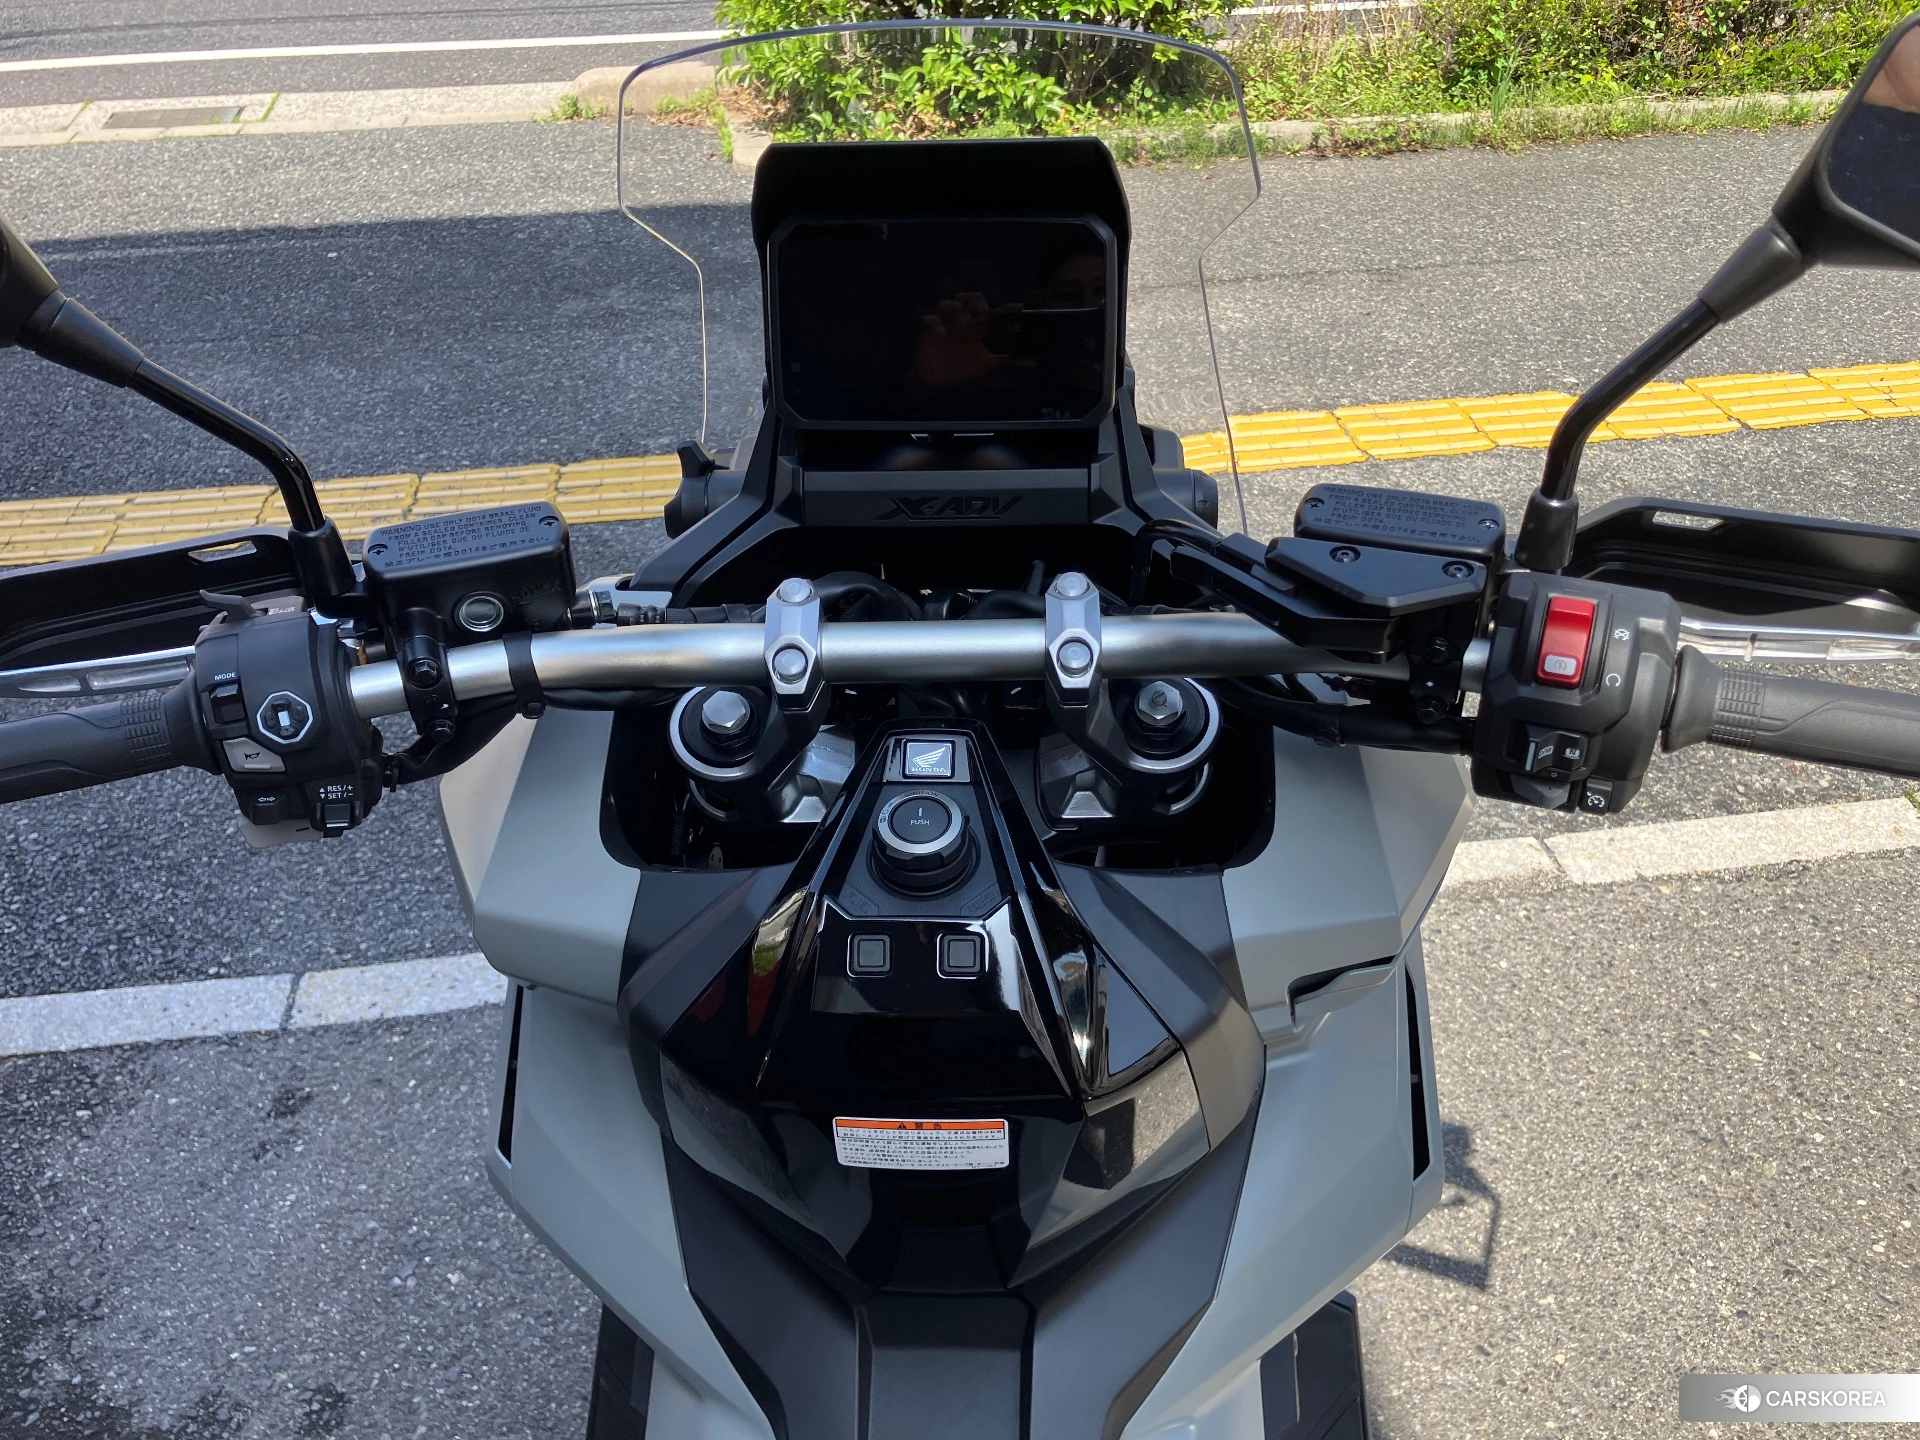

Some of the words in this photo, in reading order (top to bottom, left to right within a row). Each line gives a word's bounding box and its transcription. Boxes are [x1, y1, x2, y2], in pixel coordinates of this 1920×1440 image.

[1324, 486, 1365, 498] WARNING
[1367, 492, 1384, 500] USE
[1386, 494, 1407, 502] ONLY
[872, 495, 1025, 521] X-ADV
[1334, 500, 1366, 510] FILLER
[1367, 504, 1385, 512] CAP
[1385, 507, 1420, 517] BEFORE
[1361, 498, 1396, 507] SEALED
[380, 524, 422, 537] WARNING
[423, 522, 442, 531] USE
[443, 518, 464, 527] ONLY
[465, 514, 487, 523] DOT4
[488, 509, 517, 520] BRAKE
[518, 505, 542, 515] FLUID
[1330, 512, 1358, 521] FREIN
[1405, 515, 1418, 523] DU
[1420, 517, 1453, 527] FLUIDE
[1455, 521, 1467, 529] DE
[388, 532, 412, 542] FROM
[413, 531, 420, 539] A
[421, 525, 456, 537] SEALED
[508, 512, 537, 522] CLEAN
[471, 533, 484, 541] DU
[485, 527, 518, 539] FLUIDE
[519, 525, 531, 533] DE
[397, 536, 429, 547] FILLER
[430, 532, 448, 542] CAP
[449, 527, 482, 539] BEFORE
[399, 549, 426, 559] FREIN
[214, 671, 237, 681] MODE
